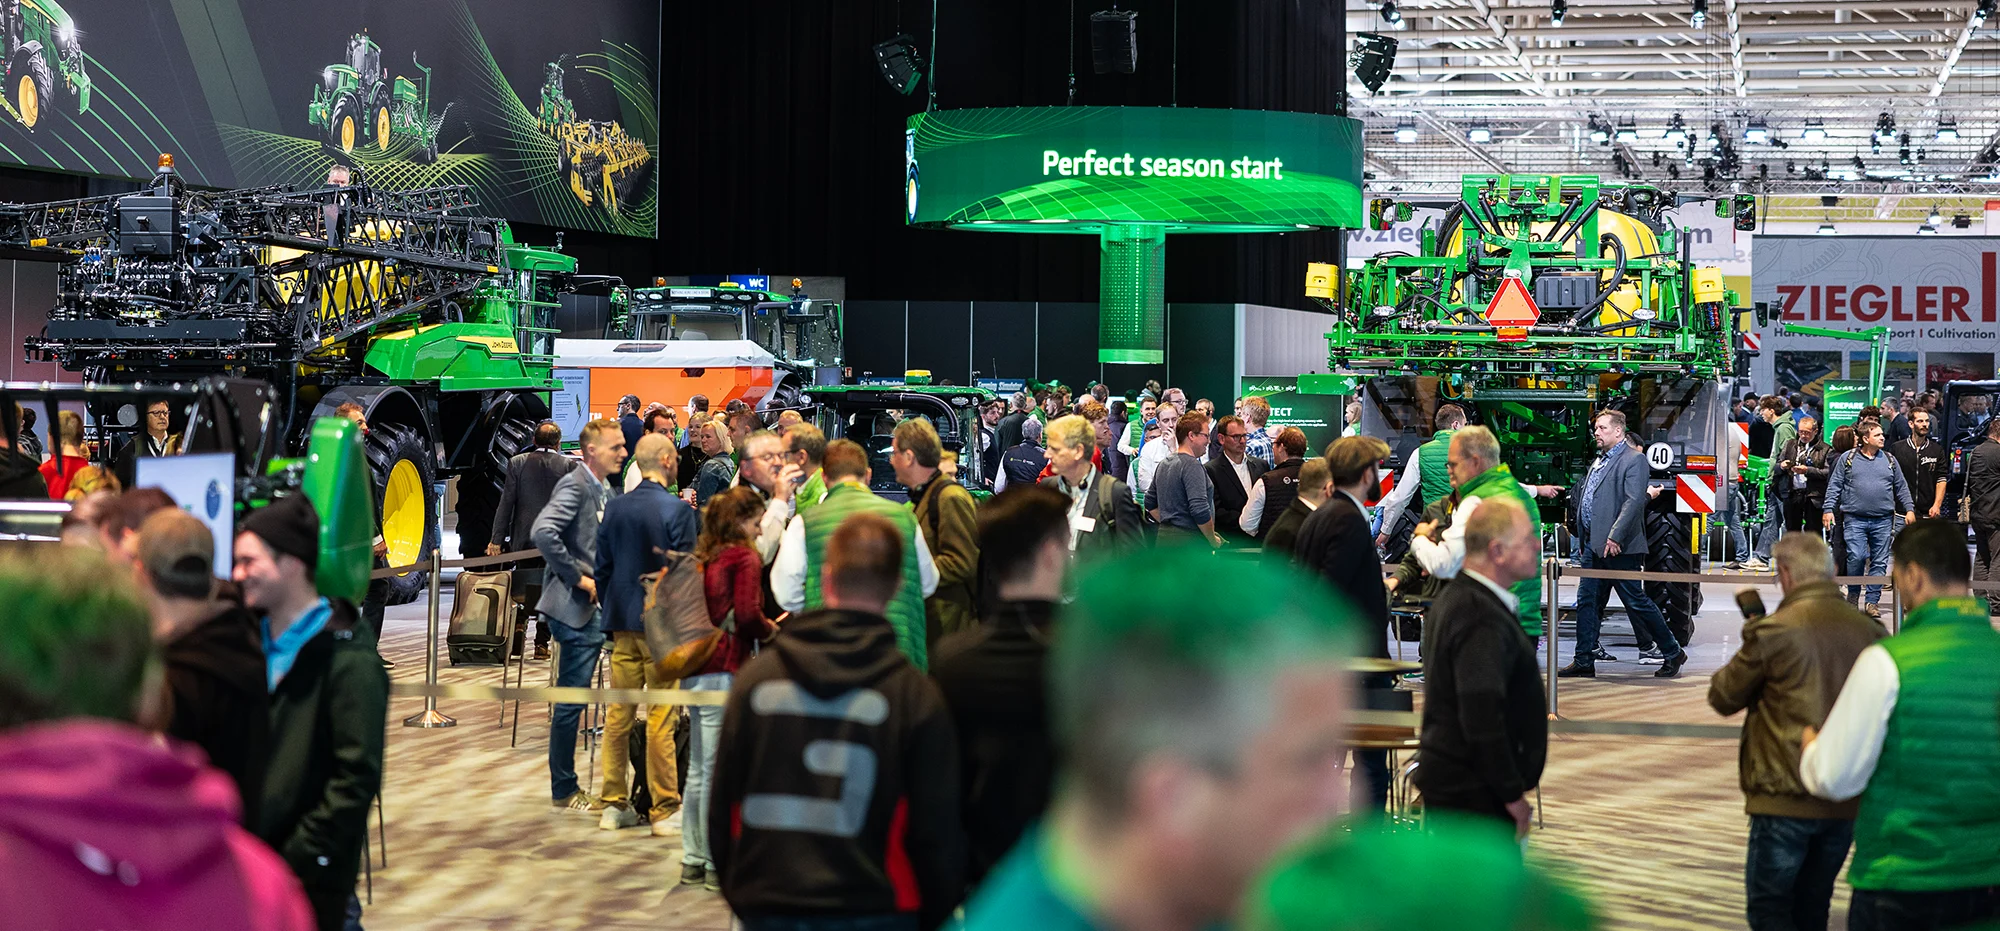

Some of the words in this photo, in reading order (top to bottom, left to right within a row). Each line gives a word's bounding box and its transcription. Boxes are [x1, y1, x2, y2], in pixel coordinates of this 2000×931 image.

[1043, 149, 1135, 176] Perfect
[1140, 157, 1225, 178] season
[1231, 156, 1283, 180] start
[748, 278, 765, 288] WC
[1776, 284, 1972, 323] ZIEGLER
[1927, 328, 1996, 339] Cultivation
[1829, 401, 1864, 409] PREPARE
[1652, 448, 1668, 465] 40
